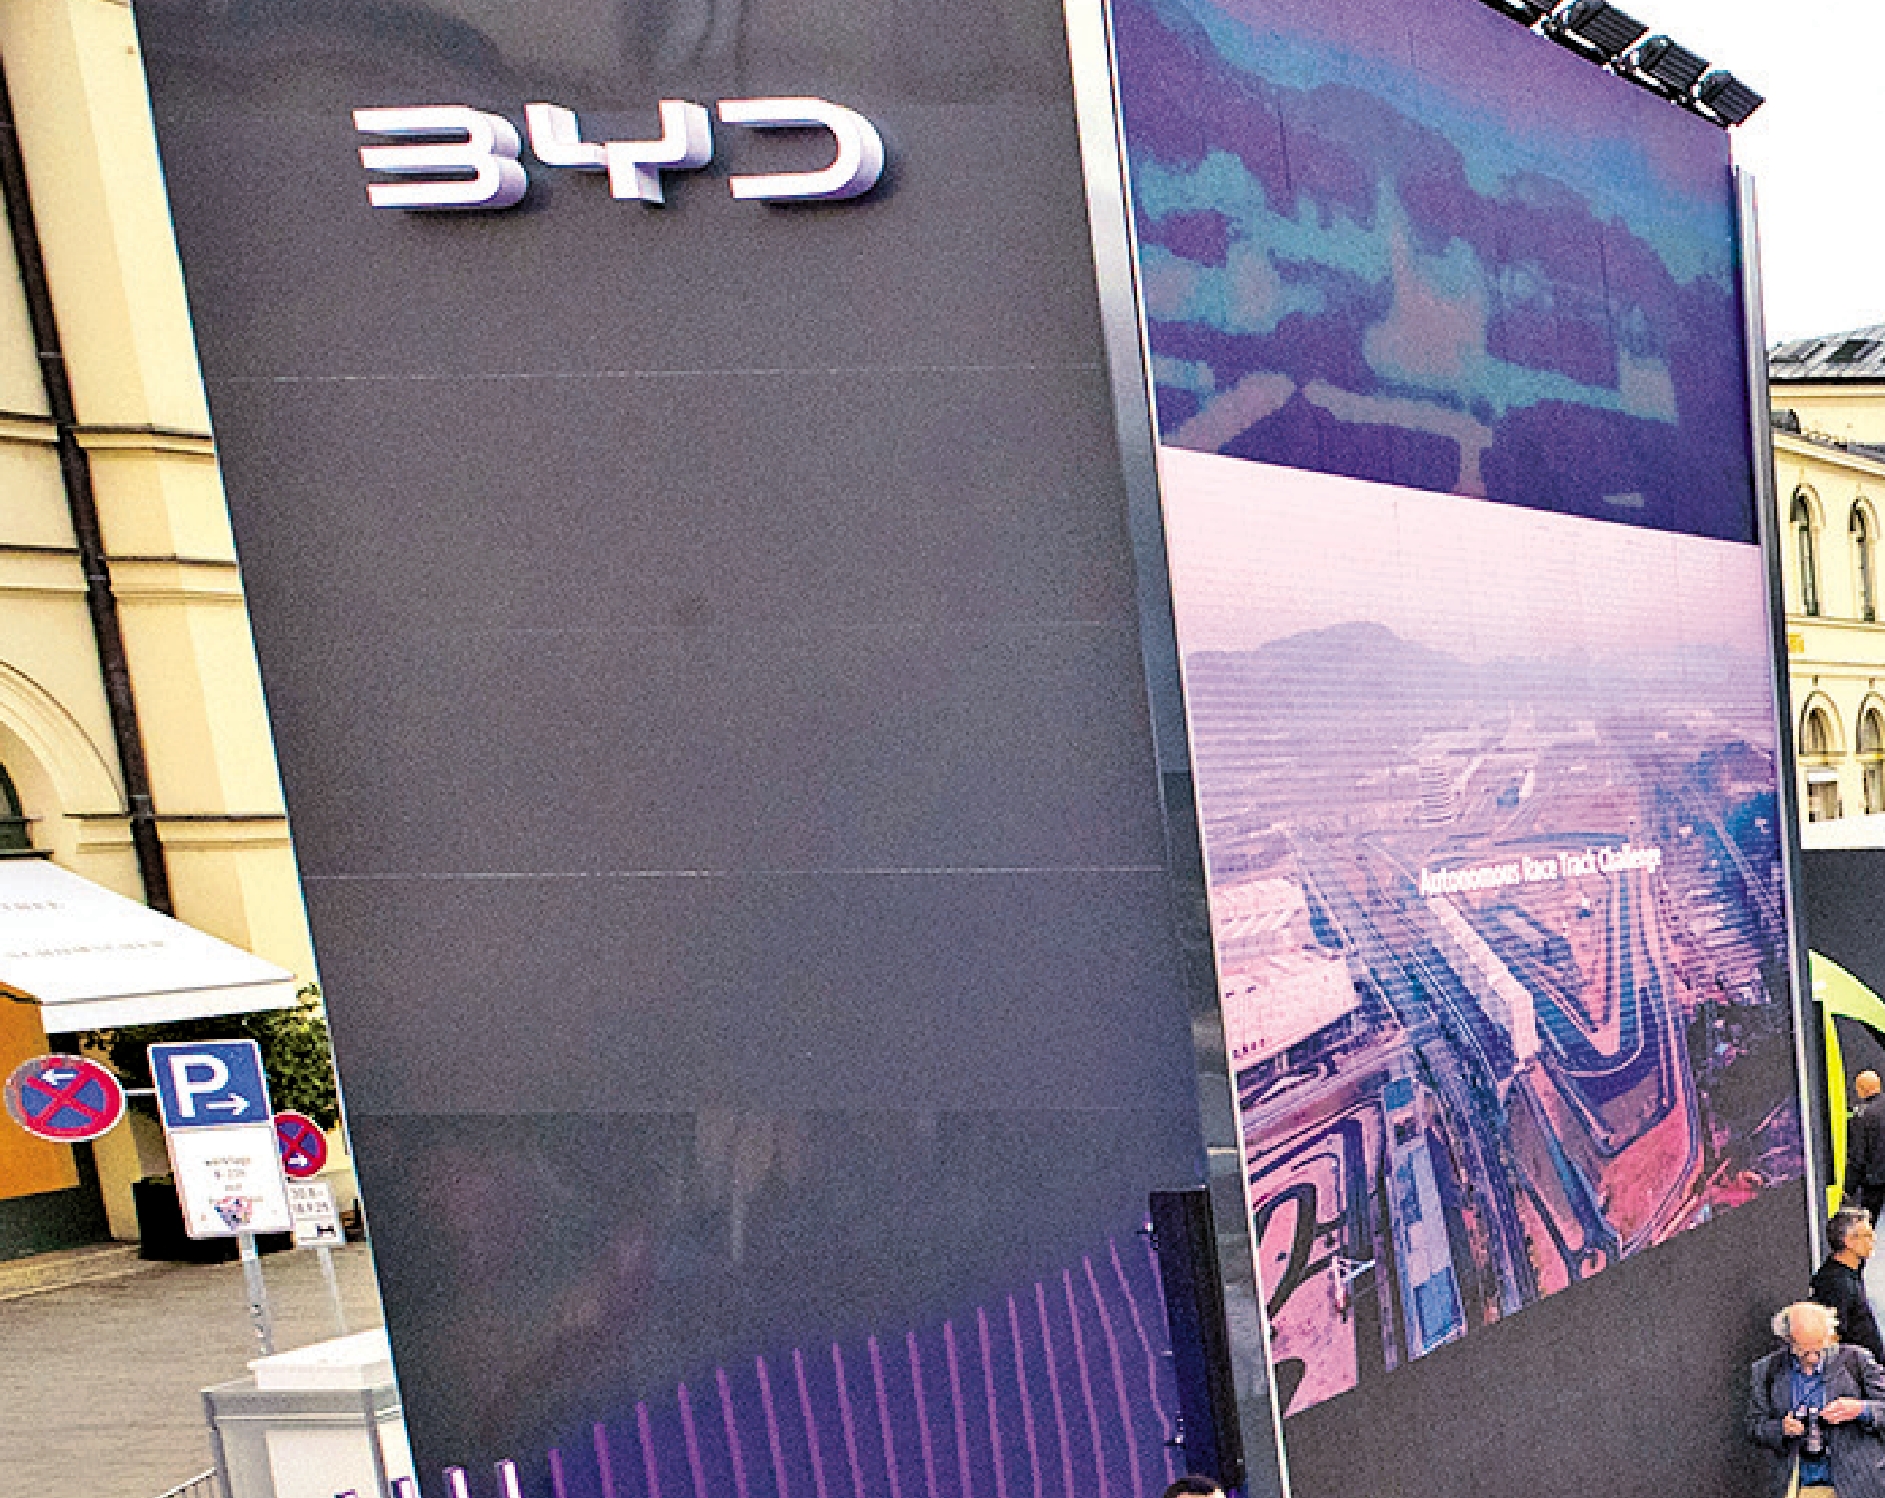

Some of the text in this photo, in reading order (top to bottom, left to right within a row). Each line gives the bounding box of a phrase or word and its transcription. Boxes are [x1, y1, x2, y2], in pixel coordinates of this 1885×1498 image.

[353, 97, 887, 211] BYD
[1421, 864, 1519, 895] Autonomous
[168, 1054, 230, 1118] P
